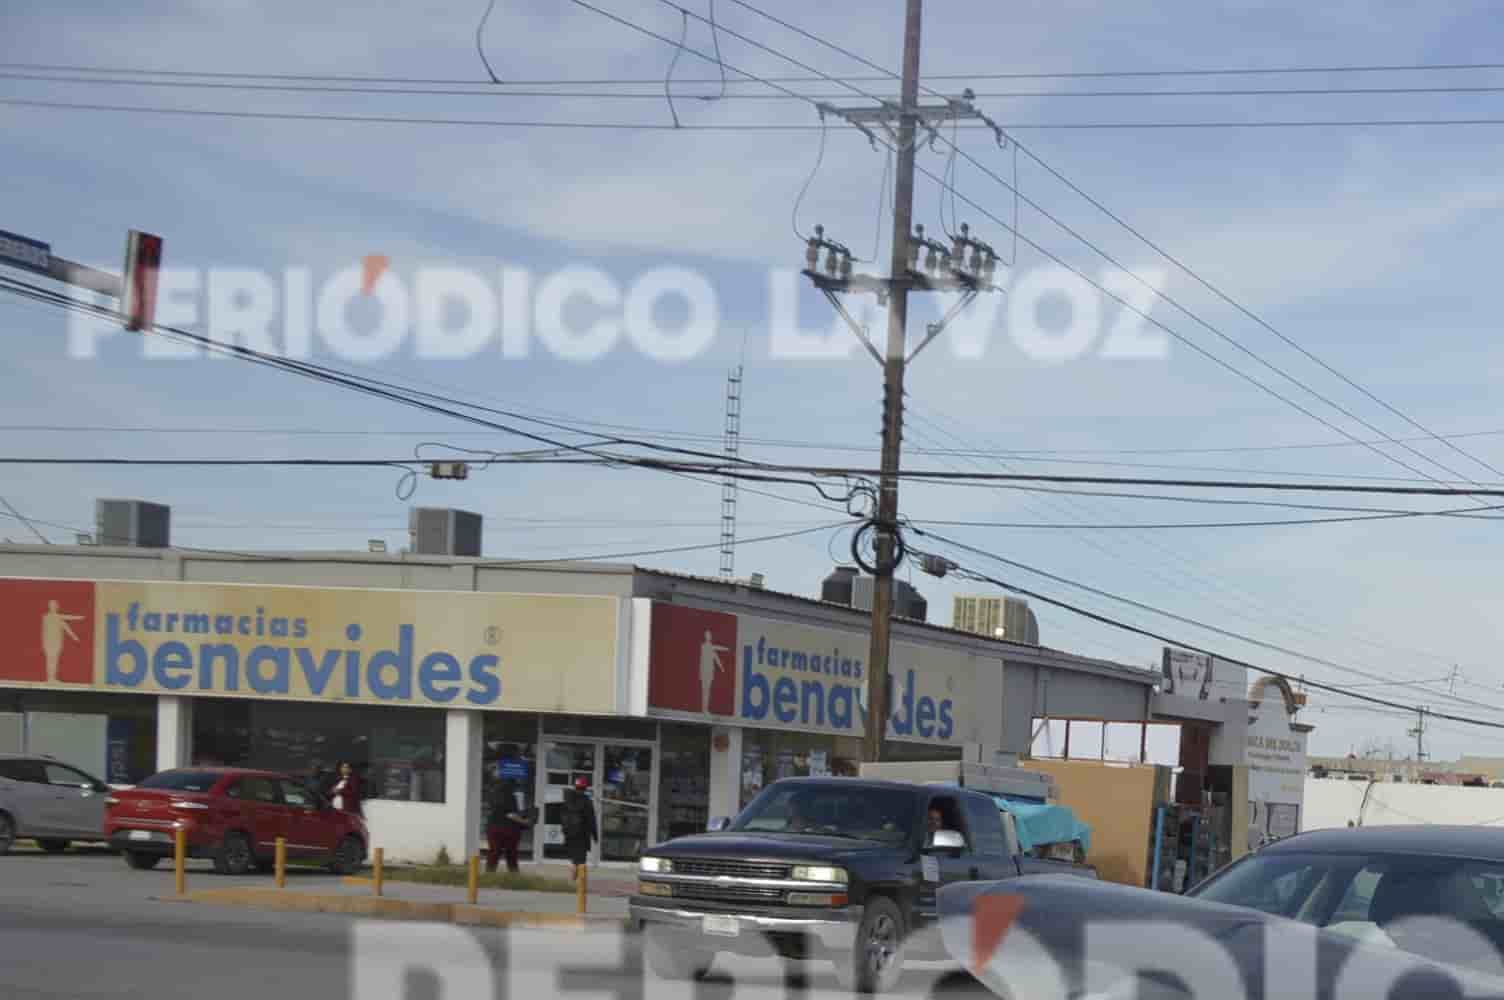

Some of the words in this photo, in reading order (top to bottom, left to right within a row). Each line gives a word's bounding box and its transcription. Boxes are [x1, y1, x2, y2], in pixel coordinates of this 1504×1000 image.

[127, 602, 308, 639] farmacias
[105, 612, 501, 704] benavides
[757, 634, 864, 678] farmacias
